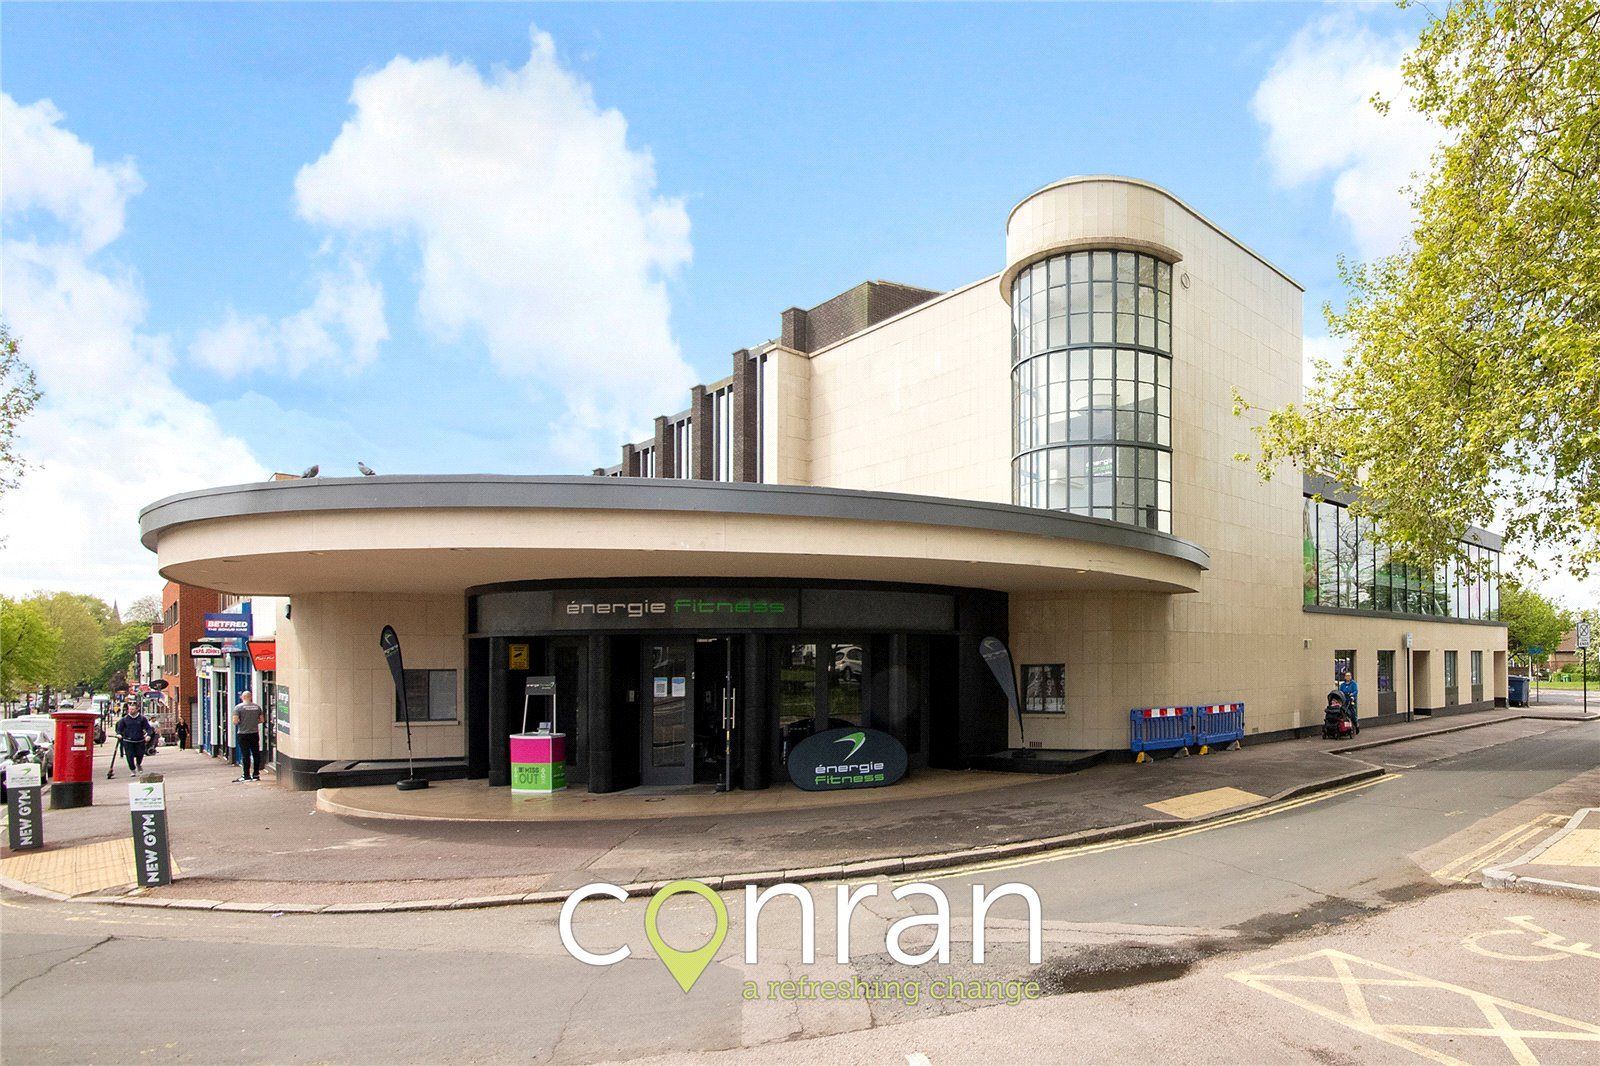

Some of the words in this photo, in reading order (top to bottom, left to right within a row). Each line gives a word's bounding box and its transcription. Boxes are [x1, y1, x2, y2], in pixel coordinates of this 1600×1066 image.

[566, 600, 666, 617] énergie
[519, 773, 539, 784] OUT
[815, 761, 884, 774] énergie
[18, 789, 32, 816] GYM
[19, 818, 33, 846] NEW
[141, 813, 157, 846] GYM
[144, 849, 160, 883] NEW
